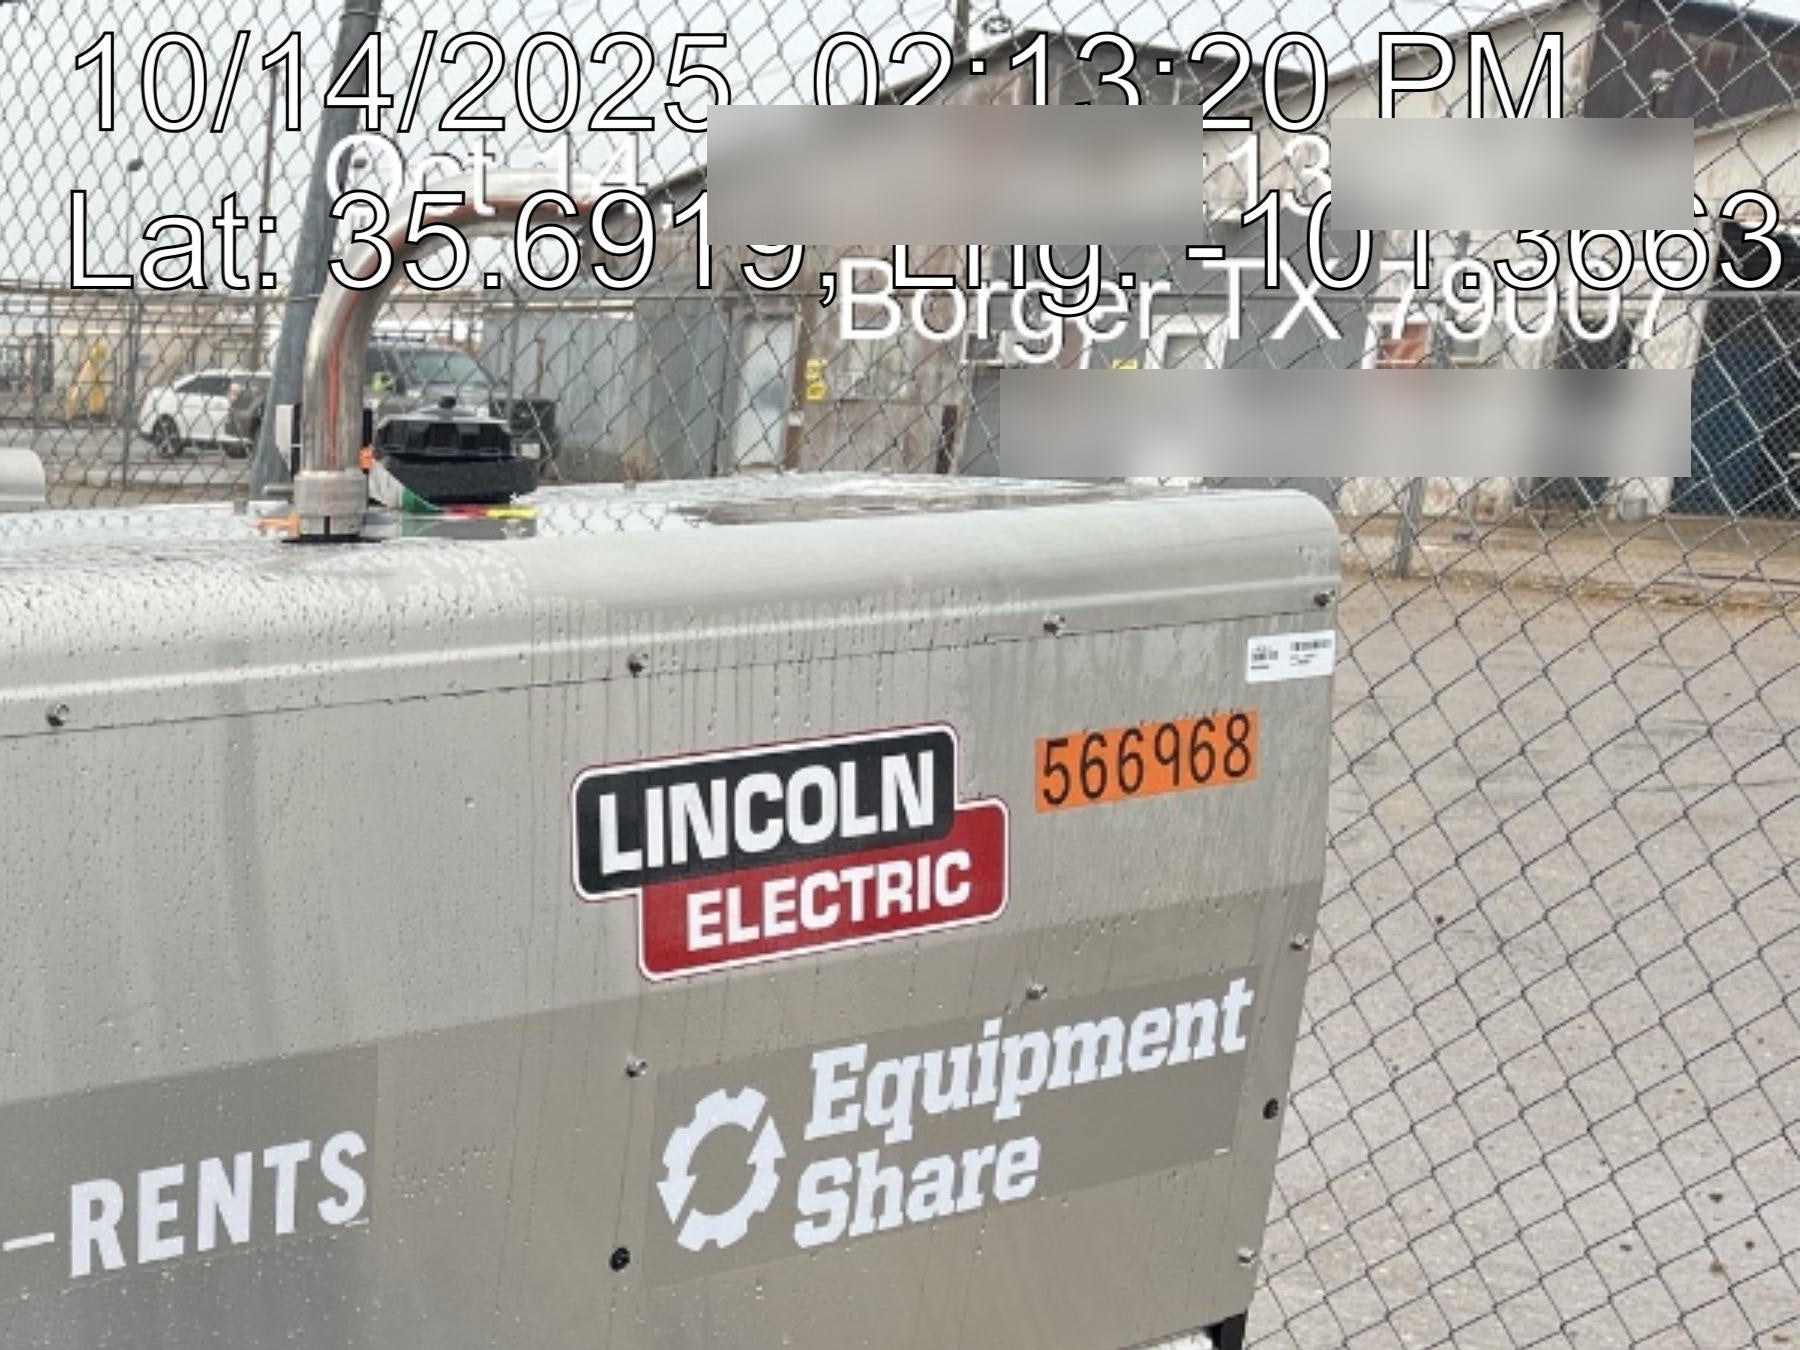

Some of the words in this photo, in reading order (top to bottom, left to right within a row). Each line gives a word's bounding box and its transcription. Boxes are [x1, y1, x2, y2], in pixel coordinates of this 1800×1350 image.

[599, 749, 934, 878] LINCOLN
[1042, 712, 1253, 806] 566968
[686, 848, 971, 952] ELECTRIC
[803, 977, 1255, 1145] Equipment
[793, 1134, 1040, 1249] Share
